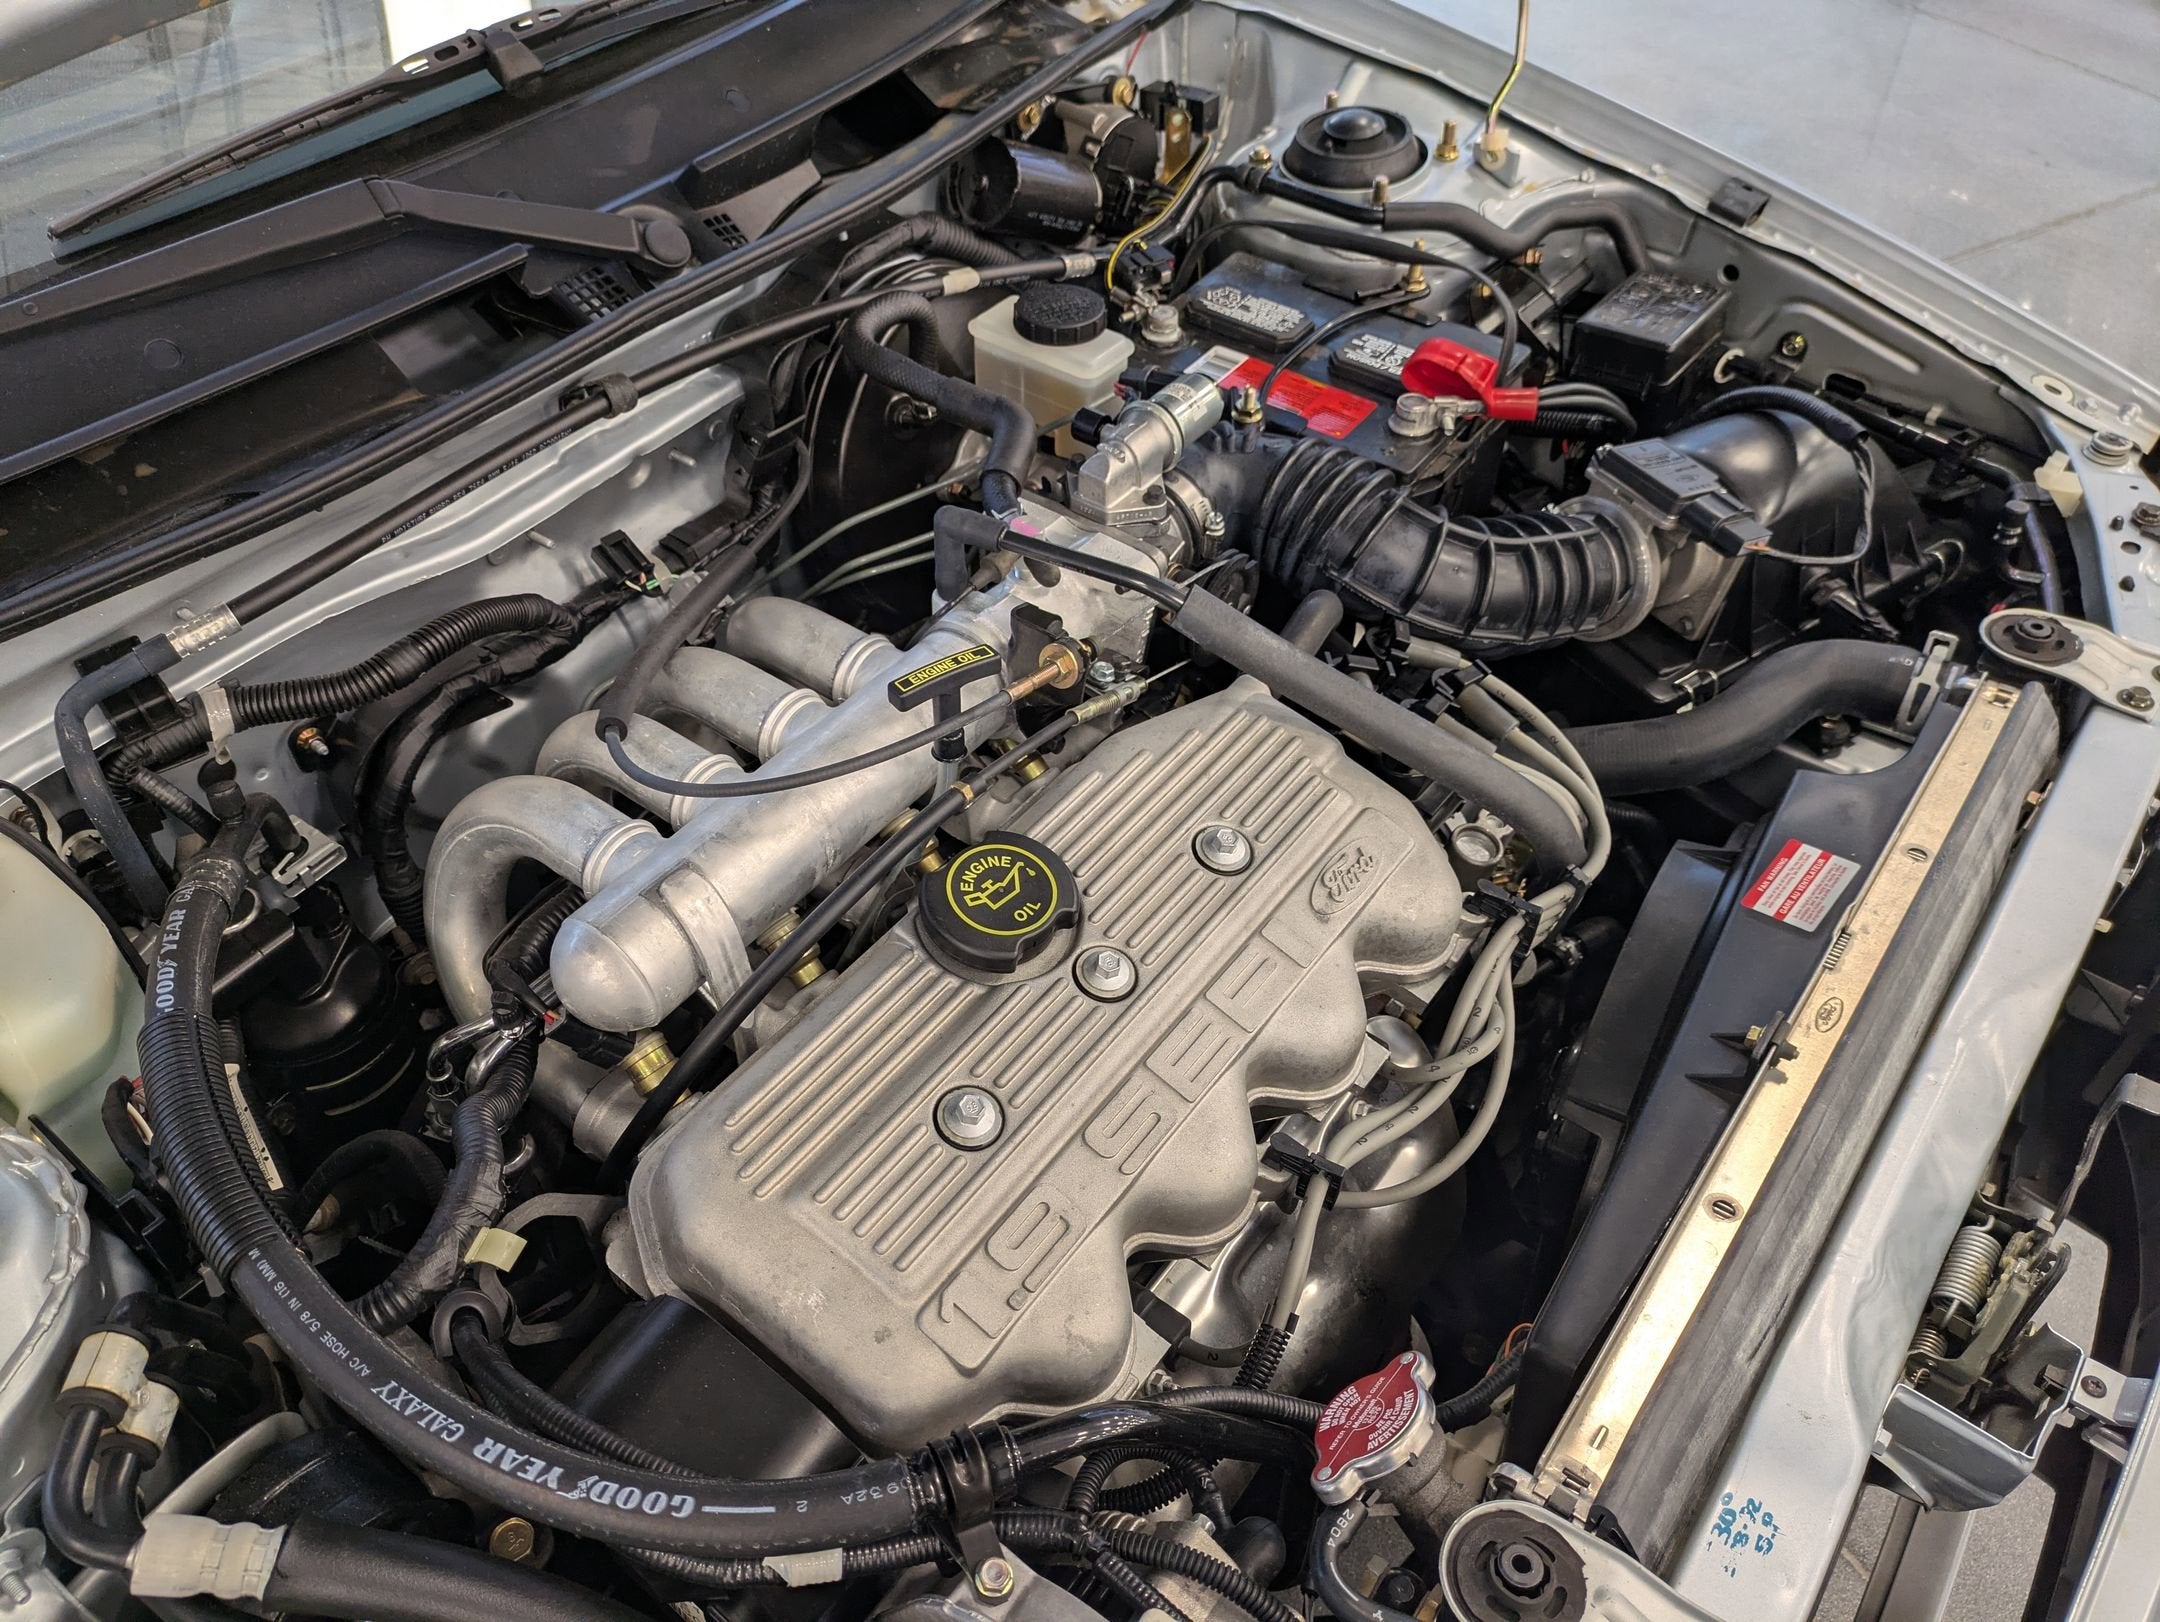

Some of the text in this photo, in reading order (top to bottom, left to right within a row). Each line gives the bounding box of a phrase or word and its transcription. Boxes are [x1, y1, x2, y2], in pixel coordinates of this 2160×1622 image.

[908, 650, 981, 685] ENGINE OIL
[960, 856, 1012, 891] ENGINE
[1317, 846, 1380, 902] Ford
[1757, 857, 1788, 892] FAN WARNING
[1779, 858, 1826, 914] GARE AU VENTILATEUR
[1014, 899, 1042, 923] OIL
[160, 909, 187, 955] YEAR
[918, 917, 1325, 1369] 1.9 SEFI
[256, 1258, 278, 1283] MM)
[287, 1297, 302, 1312] IN
[300, 1310, 322, 1333] 5/8
[320, 1330, 350, 1360] HOSE
[349, 1356, 371, 1378] A/C
[370, 1380, 466, 1443] GALAXY
[1319, 1385, 1358, 1433] WARNING
[1329, 1430, 1346, 1450] REFER
[1343, 1419, 1353, 1429] TO
[1370, 1376, 1386, 1394] GUIDE
[1366, 1388, 1415, 1451] AVERTISSEMENT
[1368, 1420, 1393, 1440] OUVRIR
[1327, 1508, 1355, 1548] 2804
